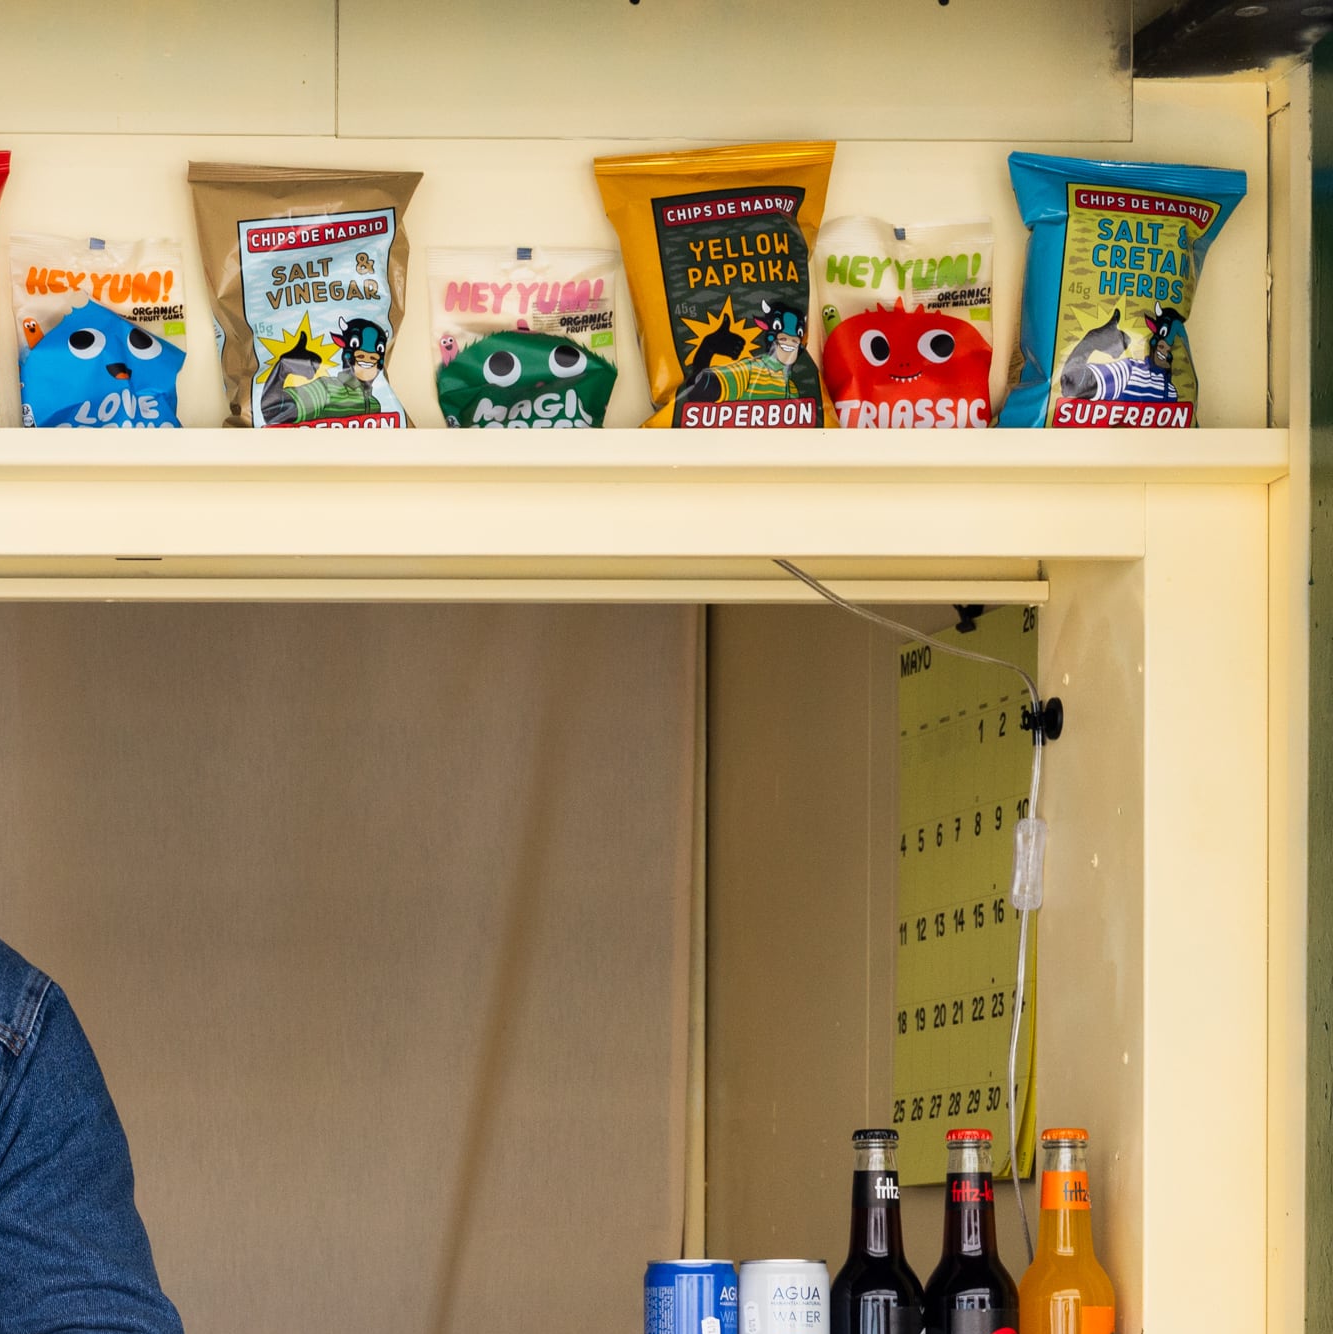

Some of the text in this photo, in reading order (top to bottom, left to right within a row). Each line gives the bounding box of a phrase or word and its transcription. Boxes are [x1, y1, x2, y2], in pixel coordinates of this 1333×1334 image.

[690, 233, 788, 261] YELLOW
[272, 252, 375, 286] SALT &
[688, 258, 799, 289] PAPRIKA
[265, 279, 380, 311] VINEGAR
[900, 647, 931, 677] MAYO
[900, 899, 1004, 945] 11 12 13 14 15 16
[773, 1286, 820, 1300] AGUA
